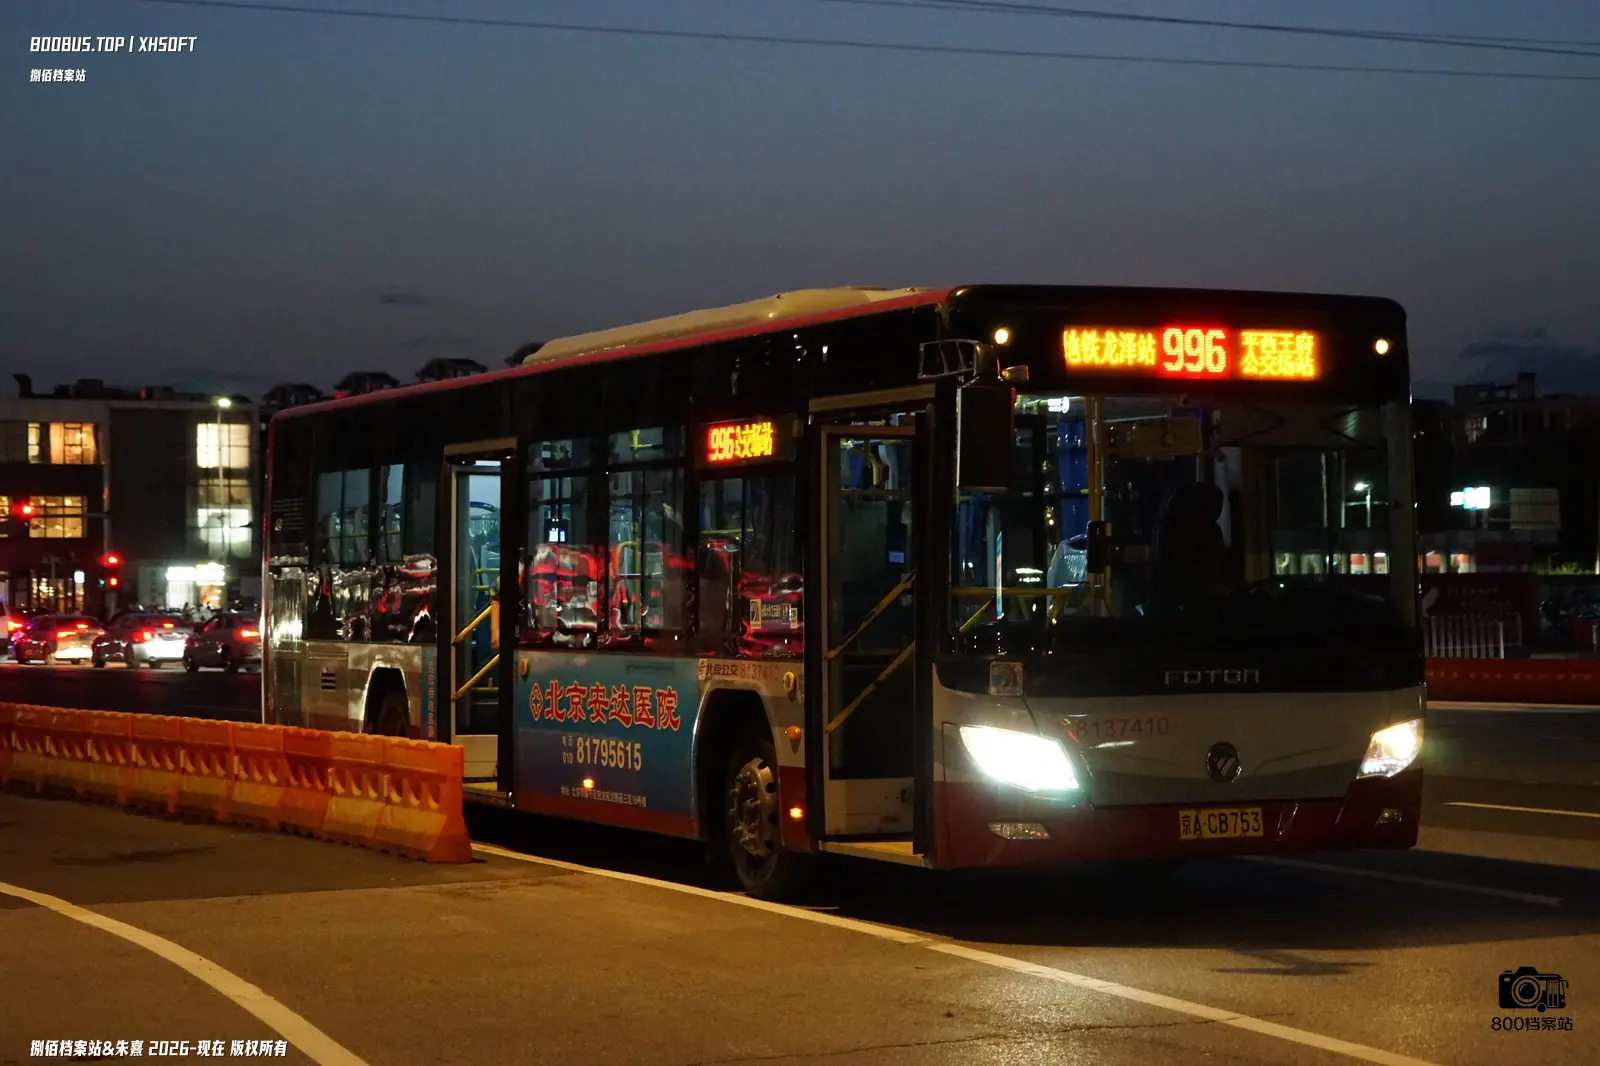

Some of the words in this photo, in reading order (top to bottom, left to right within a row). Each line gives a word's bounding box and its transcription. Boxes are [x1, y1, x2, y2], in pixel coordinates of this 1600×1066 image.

[1063, 330, 1156, 366] 地铁龙泽站
[1163, 328, 1226, 372] 996
[1241, 331, 1315, 356] 平西王府
[1241, 352, 1315, 377] 公交场站
[710, 427, 735, 461] 996
[705, 662, 738, 677] 北京公交
[544, 680, 681, 732] 北京安达医院
[1076, 716, 1169, 740] 8137410
[576, 736, 642, 771] 81795615
